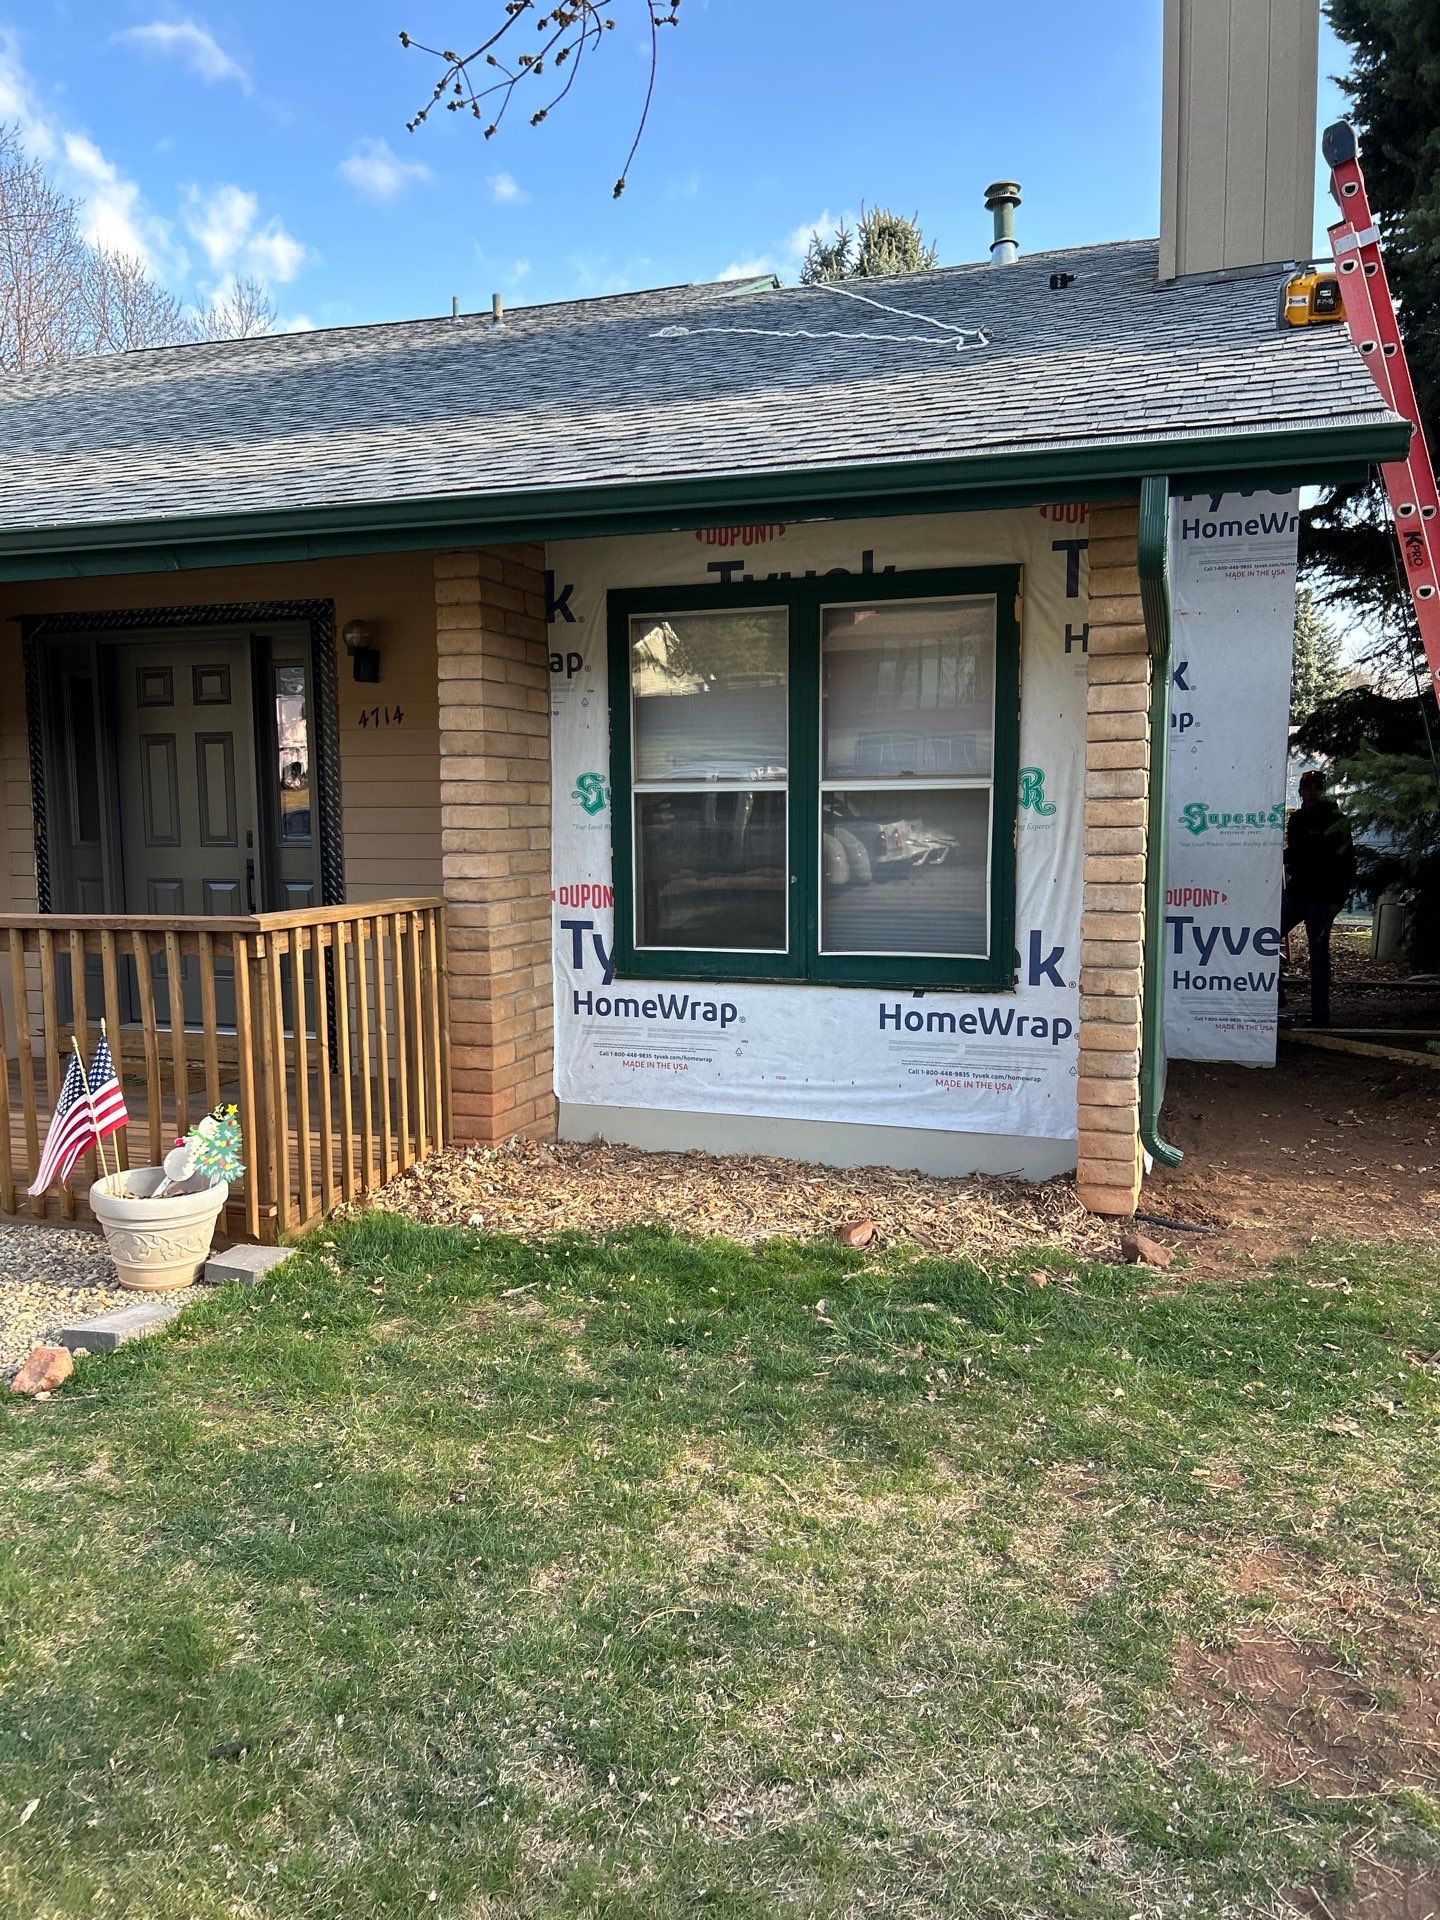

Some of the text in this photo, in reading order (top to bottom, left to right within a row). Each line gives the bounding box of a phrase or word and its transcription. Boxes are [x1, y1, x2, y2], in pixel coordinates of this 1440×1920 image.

[358, 705, 404, 729] 4714
[1166, 888, 1219, 908] DUPONT
[1173, 970, 1279, 992] HomeW
[610, 1051, 652, 1059] 1-800-448-9835
[654, 1054, 713, 1063] tyvek.com/homewrap
[622, 1060, 645, 1068] MADE
[646, 1061, 655, 1069] IN
[673, 1063, 689, 1071] USA
[921, 1069, 970, 1078] 1-800-448-9835
[972, 1073, 1042, 1083] tyvek.com/homewrap
[935, 1078, 1013, 1091] MADE IN THE USA
